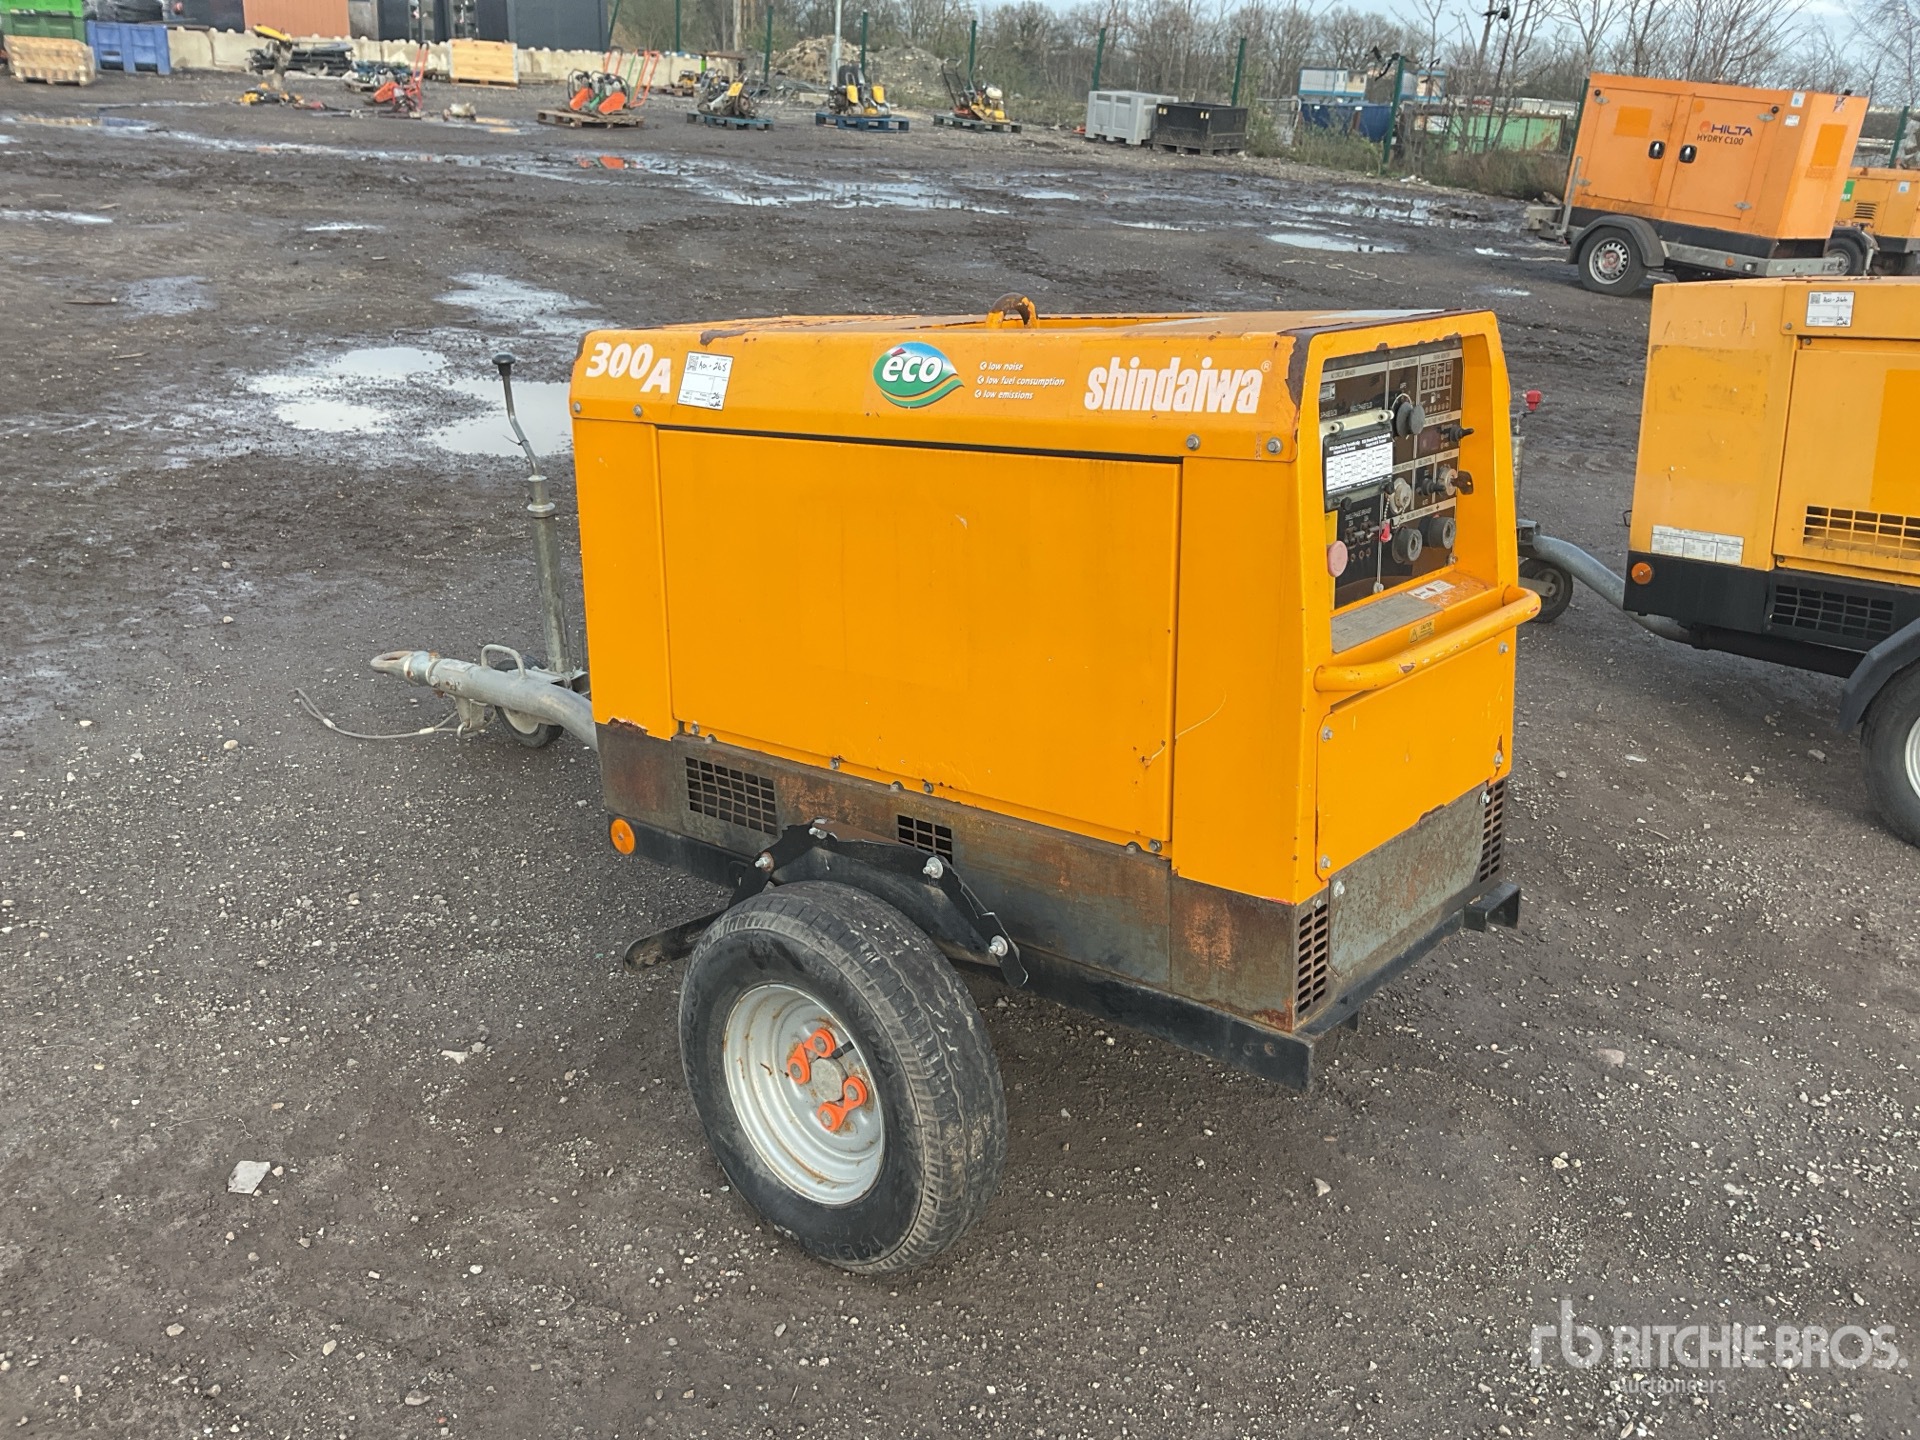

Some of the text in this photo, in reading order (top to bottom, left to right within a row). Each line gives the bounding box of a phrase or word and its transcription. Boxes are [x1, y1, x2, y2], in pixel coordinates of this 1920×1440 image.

[1711, 124, 1753, 136] HILTA
[1696, 134, 1744, 145] HYDRY C100
[585, 342, 672, 394] 300A
[988, 362, 1024, 371] low noise
[985, 376, 1065, 389] low fuel consumption
[1084, 356, 1264, 414] shindaiwa
[983, 389, 1034, 400] low emissions
